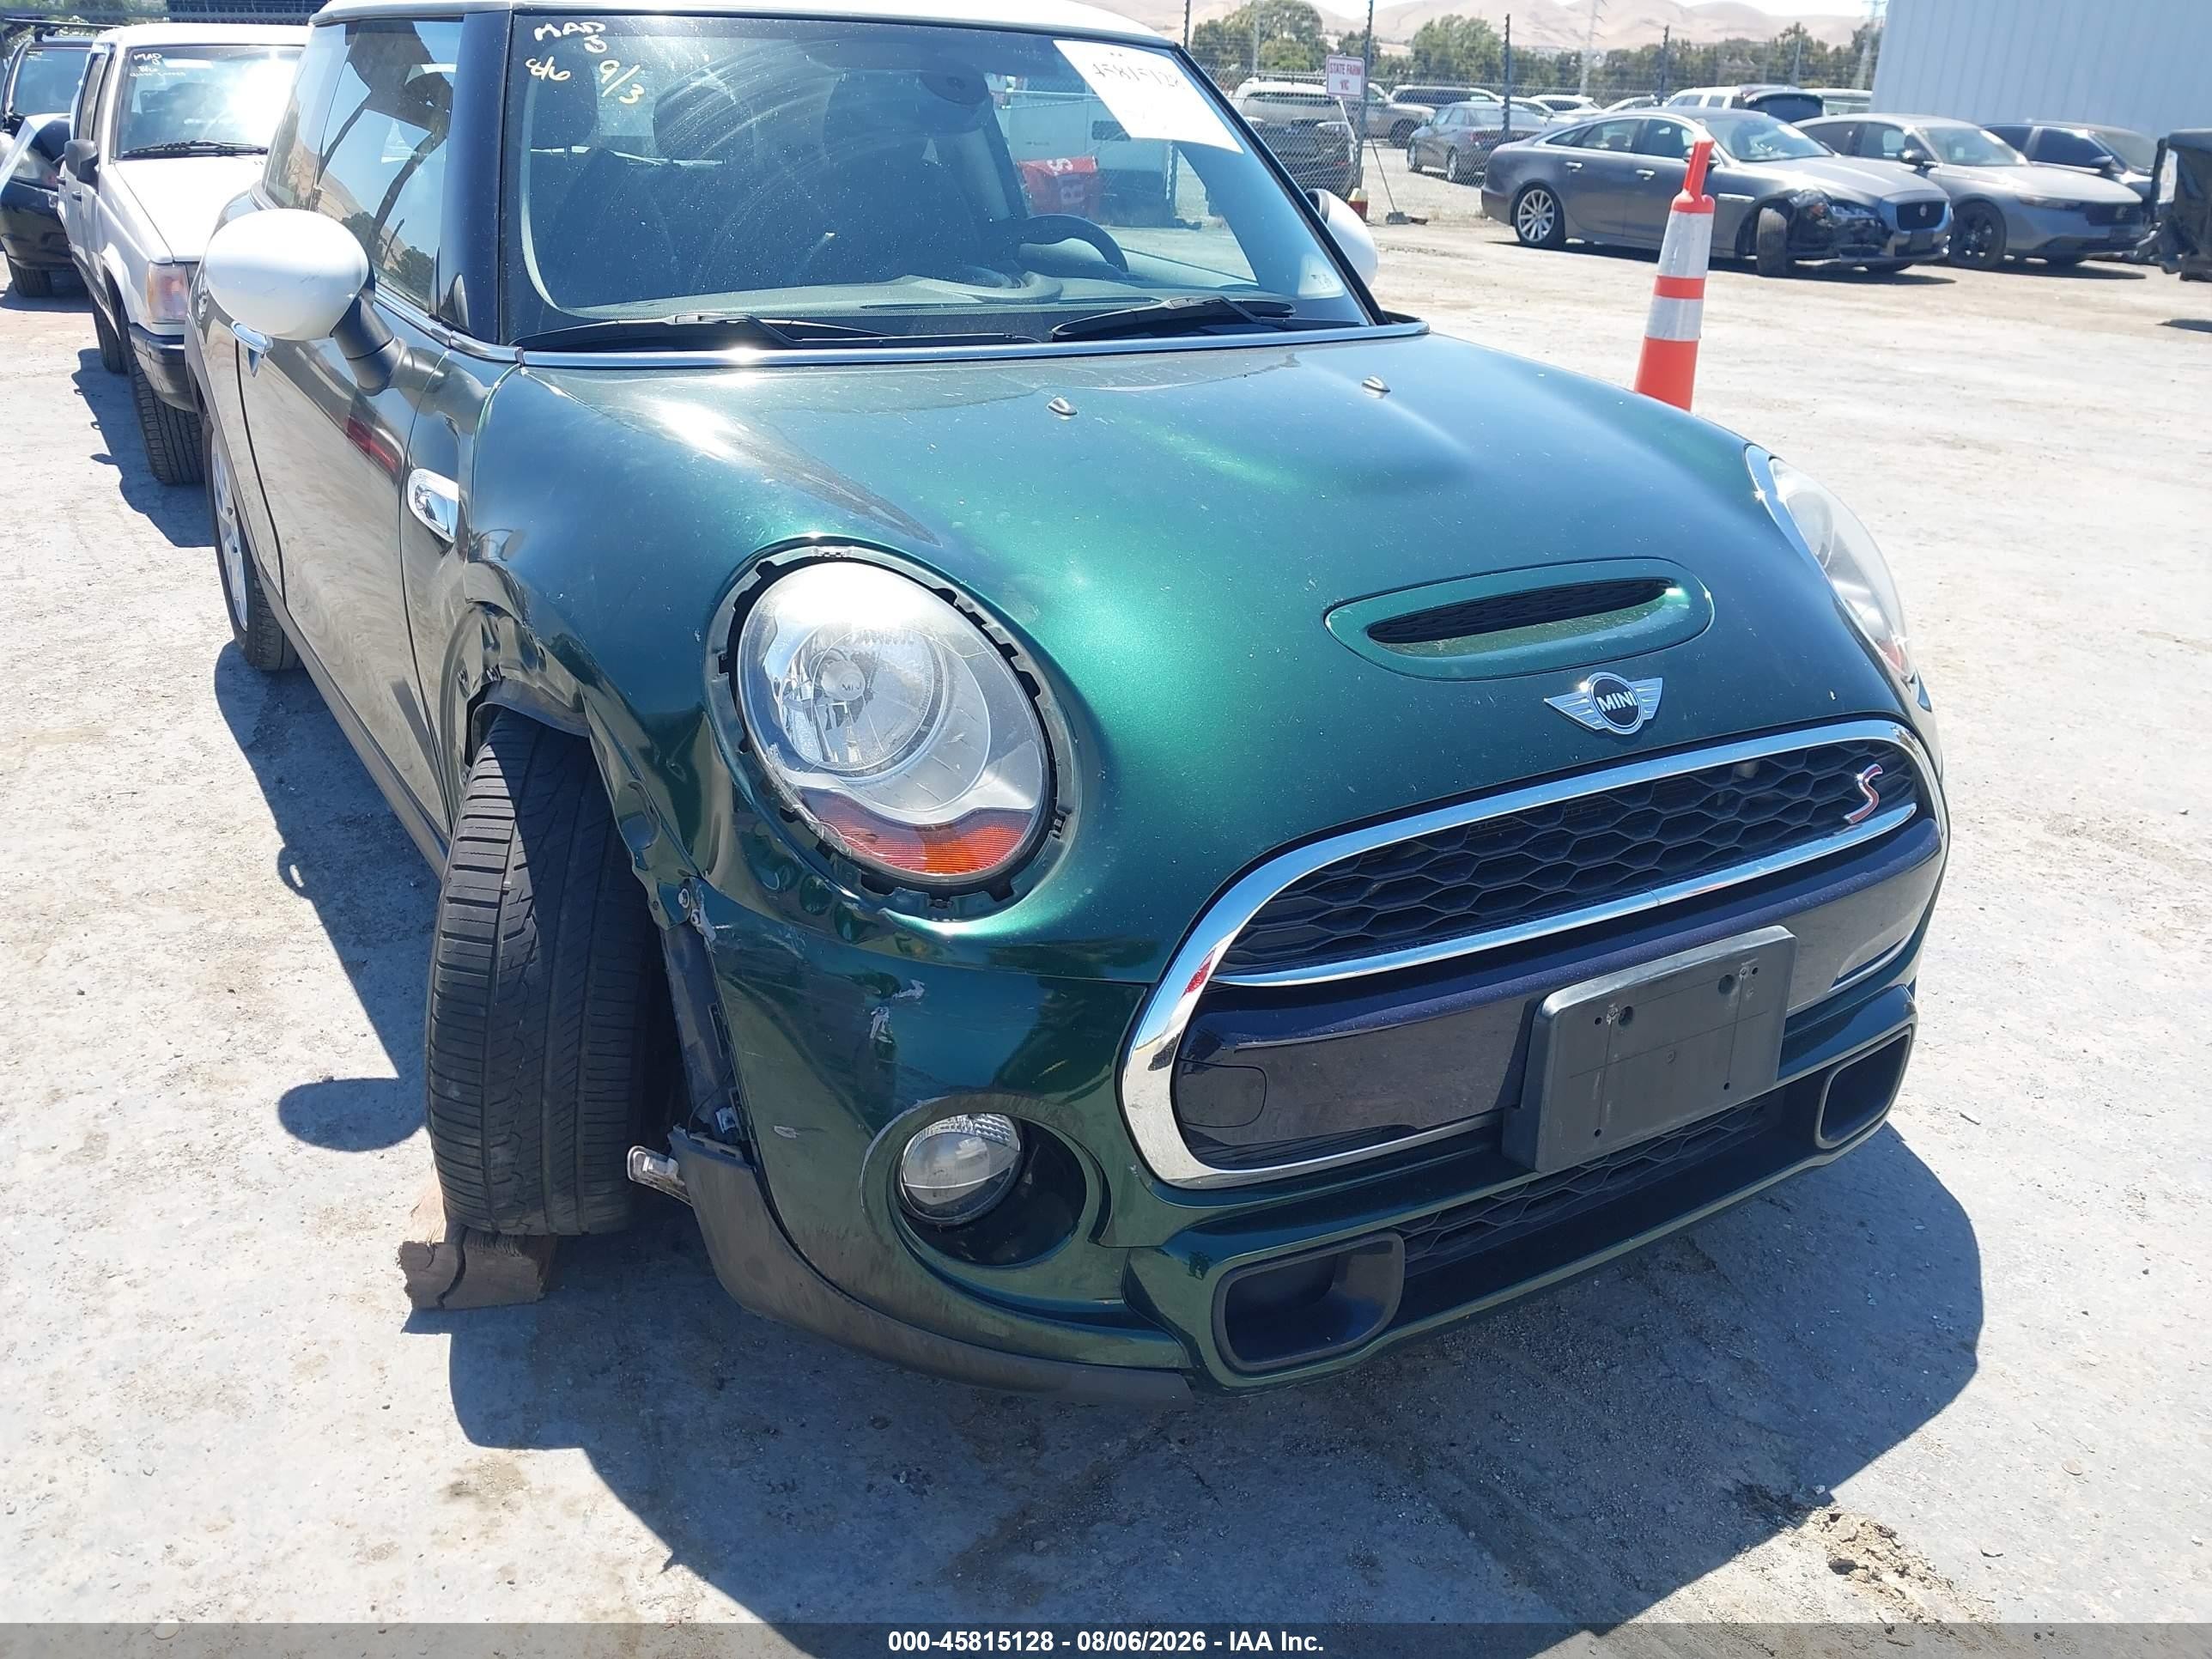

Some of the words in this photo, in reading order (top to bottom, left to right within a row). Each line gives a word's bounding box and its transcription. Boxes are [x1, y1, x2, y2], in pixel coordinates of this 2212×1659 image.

[599, 60, 645, 104] 9/3
[1330, 63, 1346, 76] STATE
[1595, 690, 1638, 713] MINI
[1844, 763, 1884, 825] S
